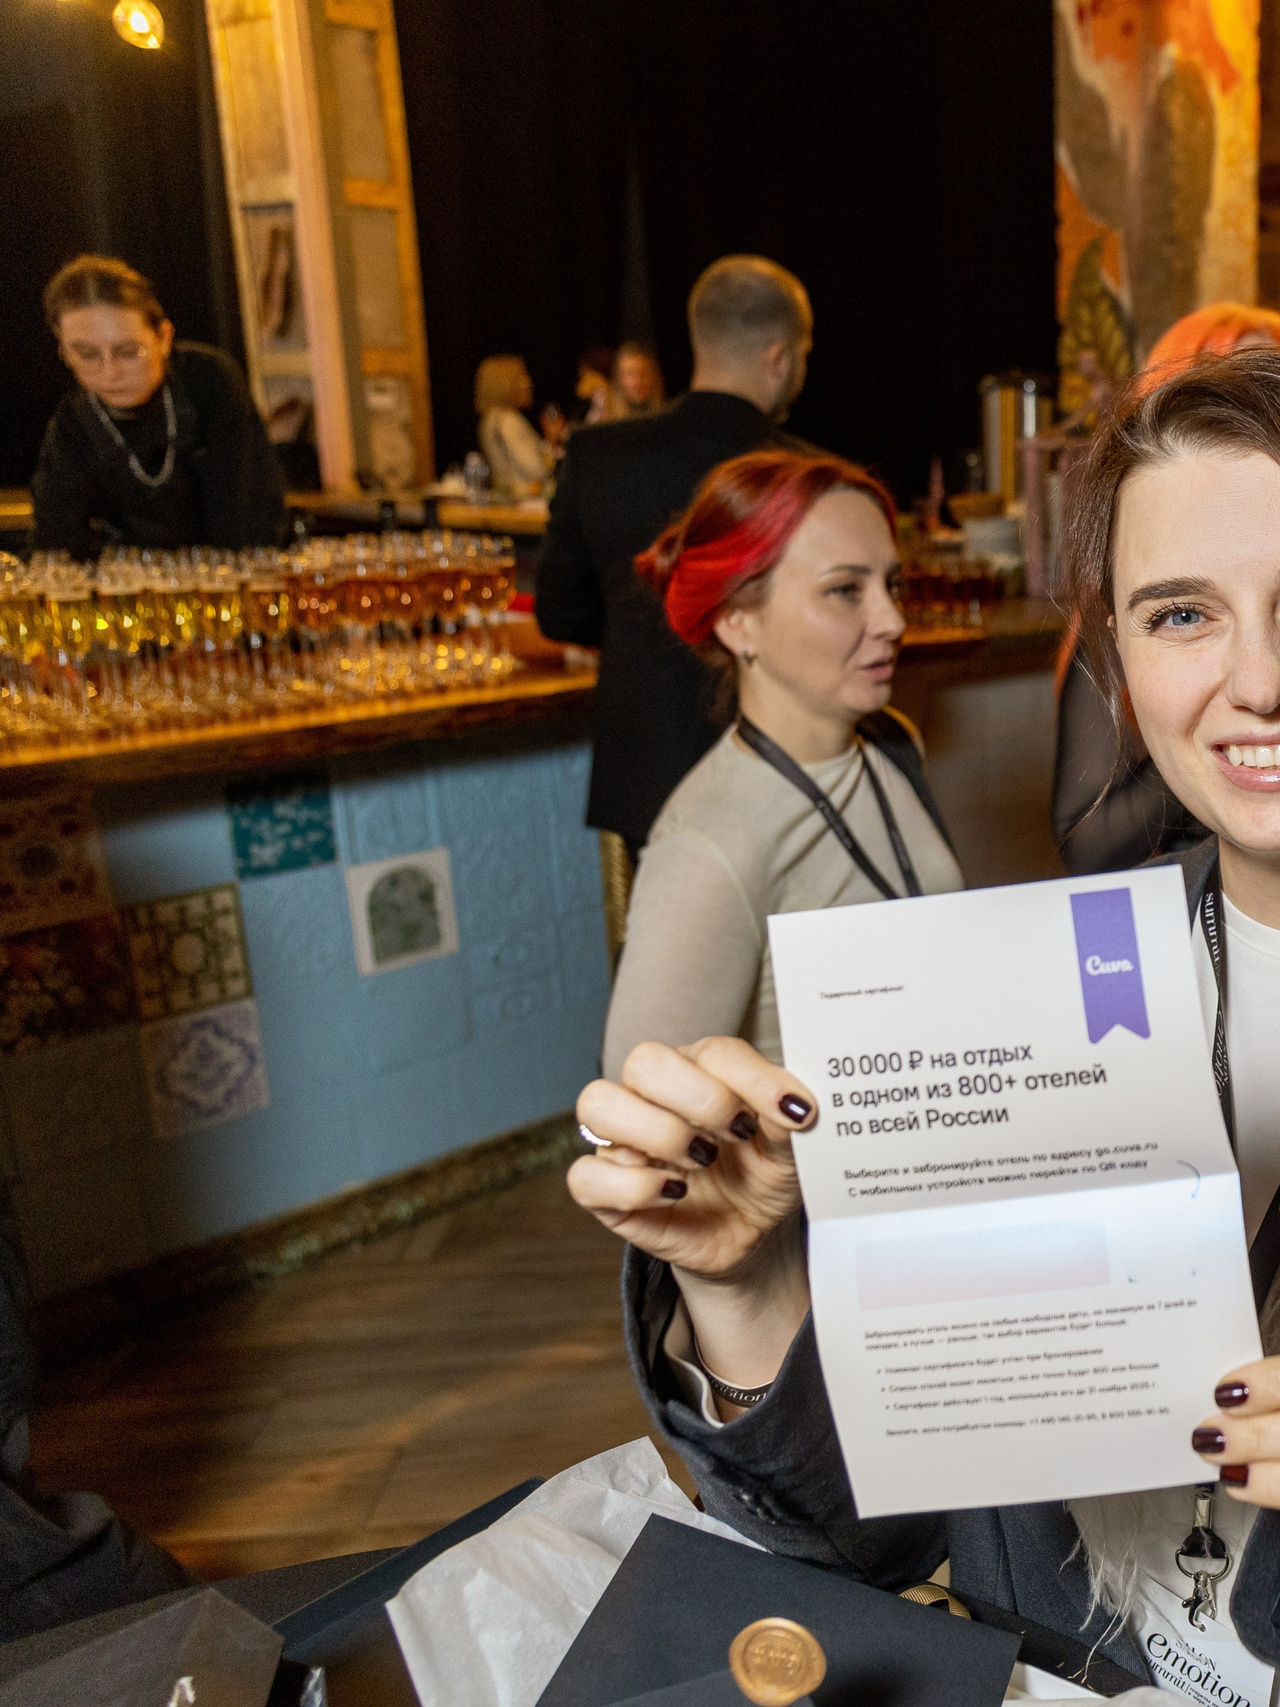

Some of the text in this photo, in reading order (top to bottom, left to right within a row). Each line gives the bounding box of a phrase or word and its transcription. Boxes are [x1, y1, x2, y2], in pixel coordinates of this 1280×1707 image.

[930, 1052, 957, 1069] на
[963, 1045, 1033, 1067] отдых
[832, 1063, 1107, 1109] в одном из 800+ отелей
[836, 1107, 1010, 1137] по всей России
[843, 1167, 900, 1180] Выберите
[913, 1158, 994, 1174] забронируйте
[996, 1156, 1030, 1166] отель
[1032, 1153, 1048, 1162] по
[1050, 1149, 1092, 1161] адресу
[859, 1184, 924, 1197] мобильных
[925, 1177, 985, 1192] устройств
[987, 1173, 1027, 1184] можно
[1029, 1166, 1079, 1180] перейти
[1081, 1165, 1097, 1174] по
[1099, 1161, 1117, 1172] QR
[1119, 1159, 1148, 1170] коду
